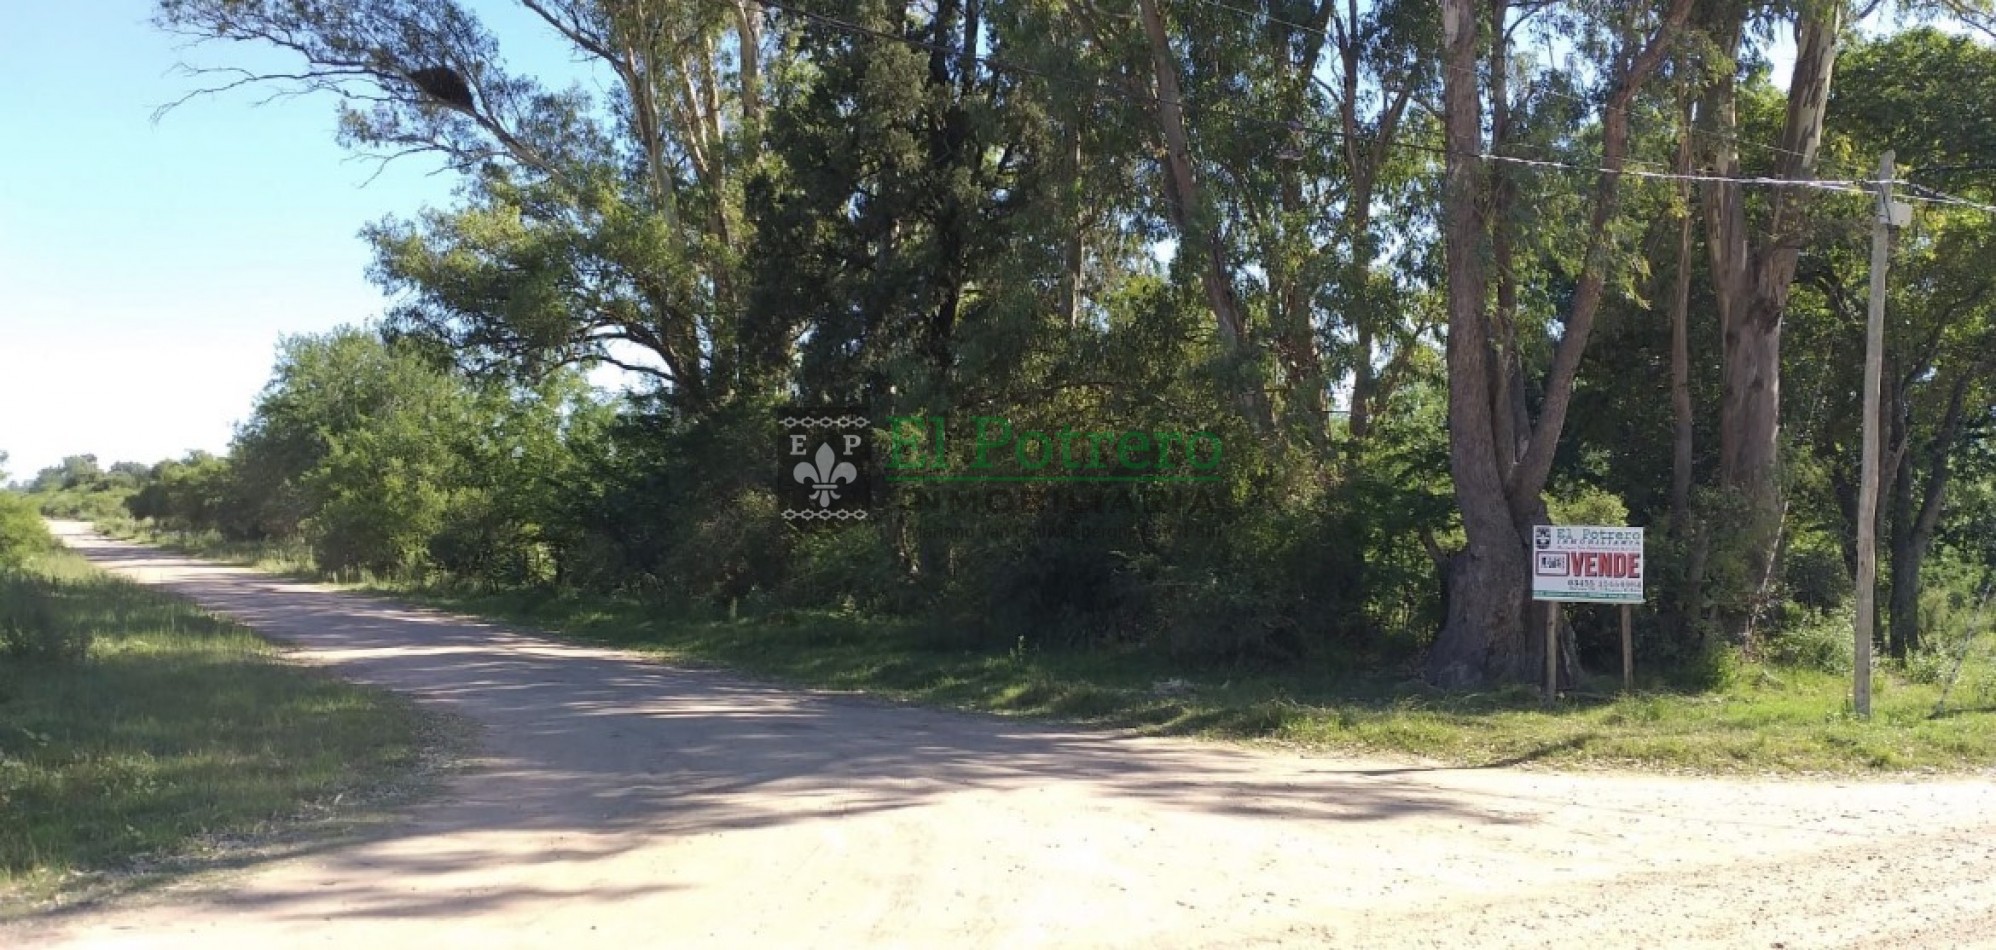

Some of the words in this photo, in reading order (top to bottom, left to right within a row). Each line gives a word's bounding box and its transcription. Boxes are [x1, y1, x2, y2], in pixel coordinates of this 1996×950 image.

[1557, 529, 1572, 539] El
[1583, 529, 1640, 539] Potrero
[1571, 552, 1640, 578] VENDE
